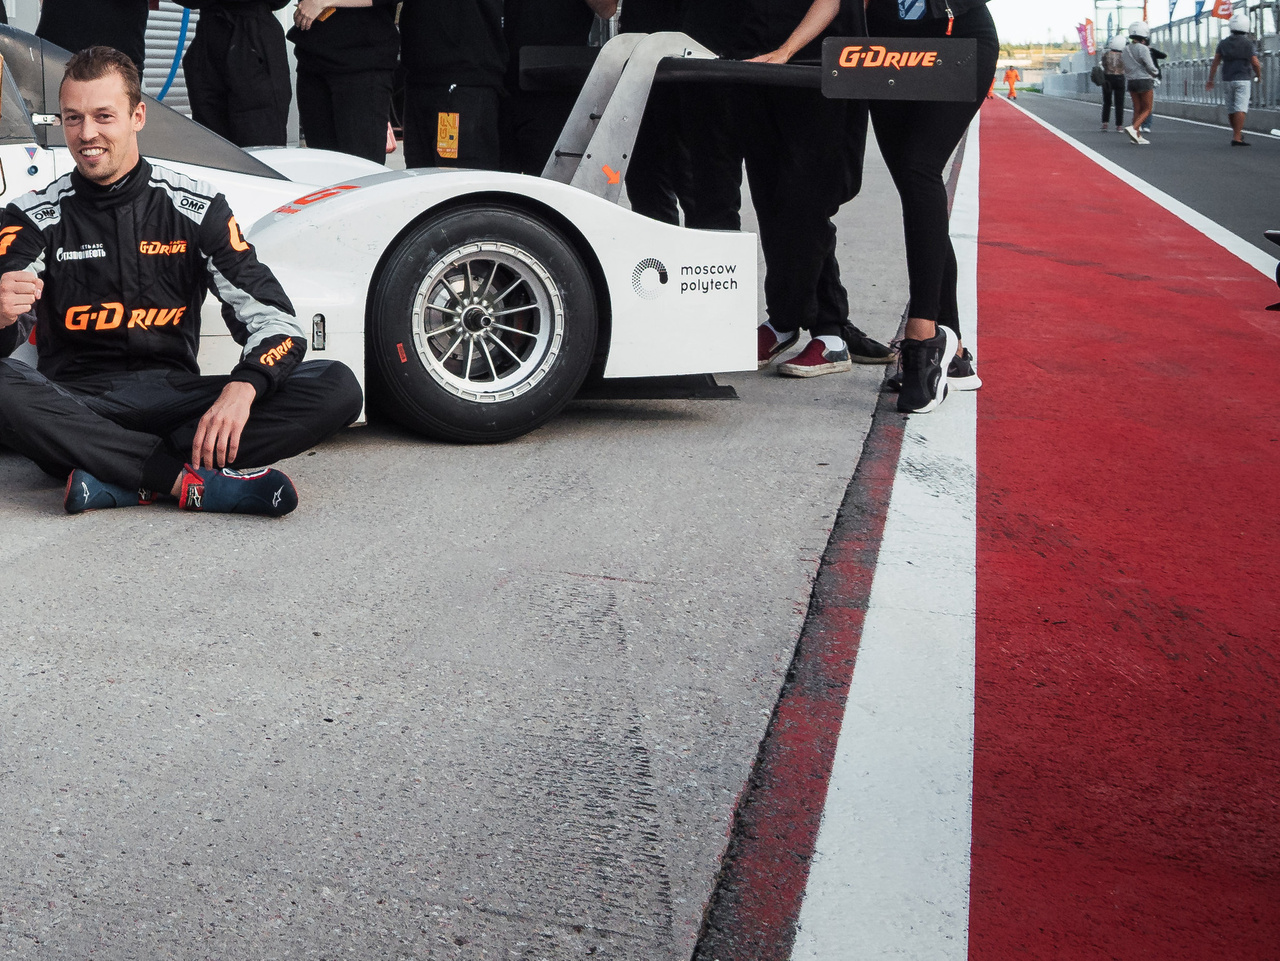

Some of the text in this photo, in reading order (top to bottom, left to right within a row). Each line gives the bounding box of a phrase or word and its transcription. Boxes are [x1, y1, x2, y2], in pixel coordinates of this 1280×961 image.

[180, 197, 206, 213] OMP
[34, 207, 56, 221] OMP
[680, 264, 737, 276] moscow
[680, 277, 738, 295] polytech
